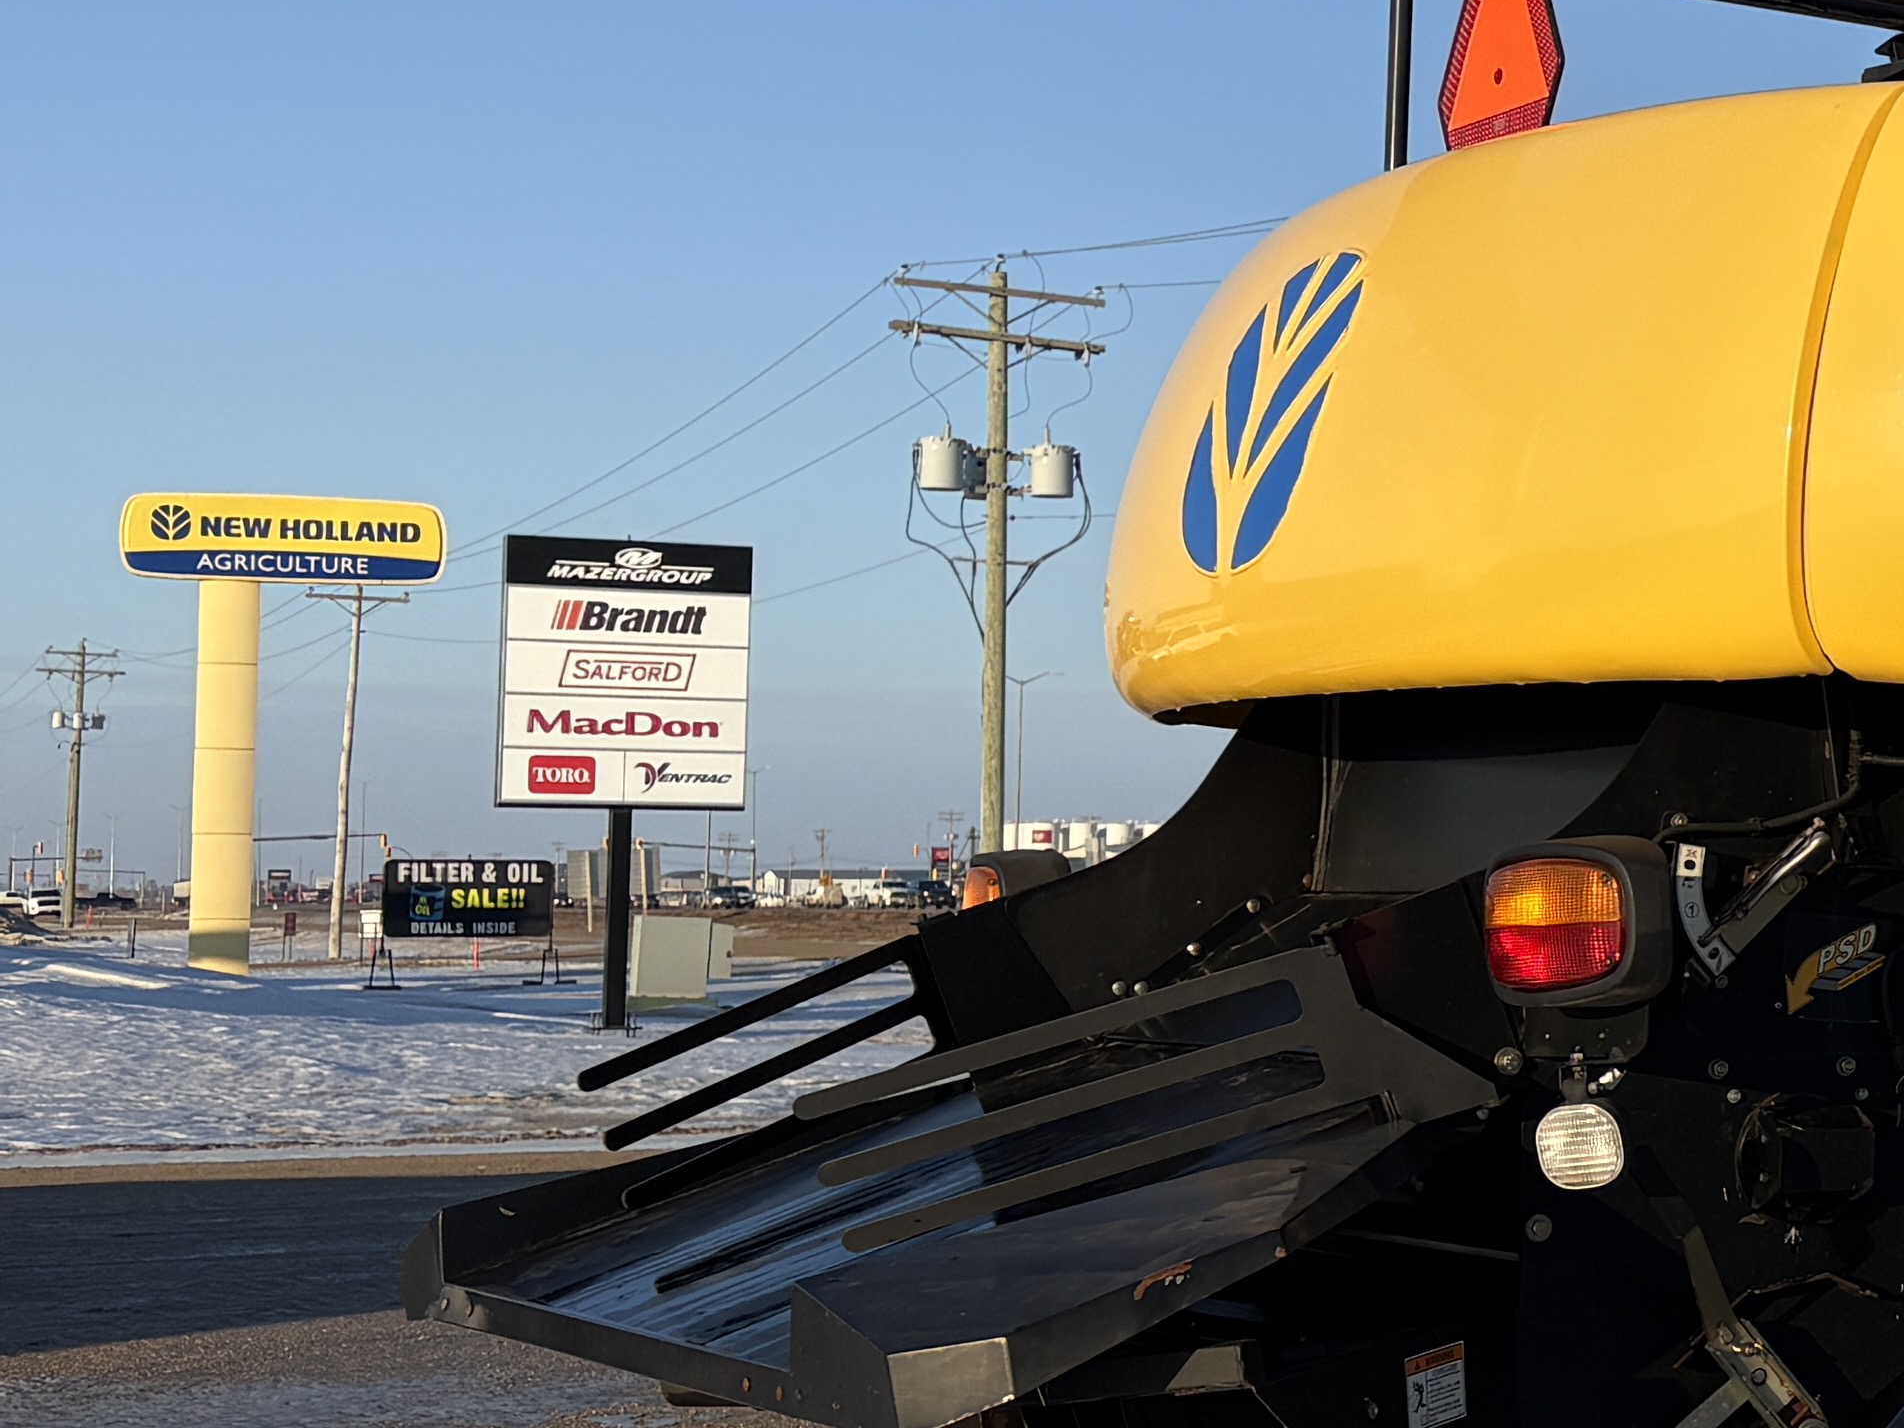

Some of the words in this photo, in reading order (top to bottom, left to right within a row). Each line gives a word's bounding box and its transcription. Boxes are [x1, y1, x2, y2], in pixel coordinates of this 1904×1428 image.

[200, 515, 272, 539] NEW
[280, 518, 421, 543] HOLLAND
[196, 553, 369, 575] AGRICULTURE
[546, 564, 712, 585] MAZERGROUP
[579, 600, 708, 635] Brandt
[572, 658, 683, 683] SALFORD
[526, 708, 720, 738] MacDon
[532, 766, 590, 783] TORO
[397, 862, 475, 884] FILTER
[481, 862, 497, 884] &
[507, 862, 544, 884] OIL
[451, 888, 526, 909] SALE!!
[410, 922, 465, 934] DETAILS
[472, 921, 516, 934] INSIDE
[1818, 923, 1877, 974] PSD
